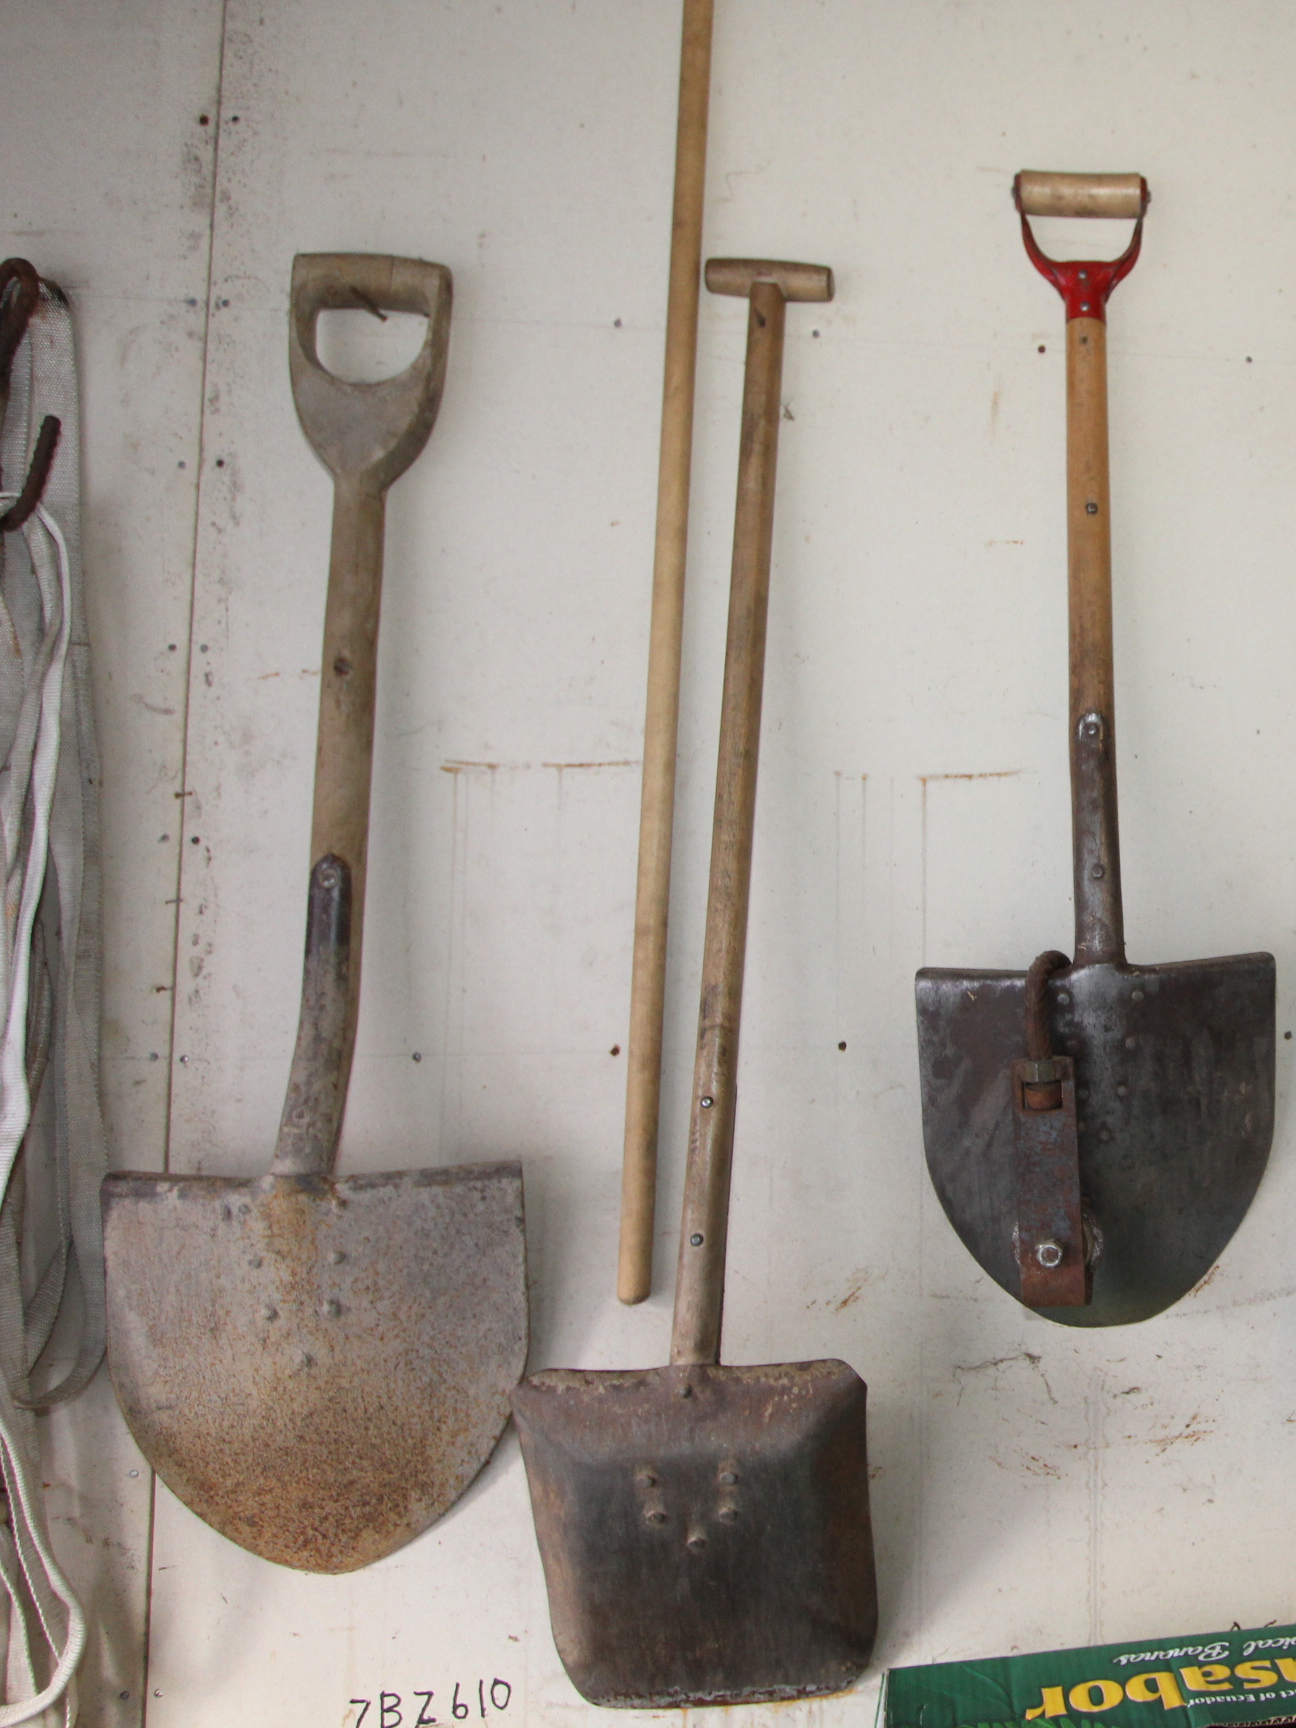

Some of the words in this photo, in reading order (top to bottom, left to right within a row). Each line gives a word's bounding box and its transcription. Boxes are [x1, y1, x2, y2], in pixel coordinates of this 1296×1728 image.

[1113, 1642, 1229, 1665] Bananas
[1187, 1694, 1256, 1709] Ecuador
[1258, 1690, 1277, 1702] of
